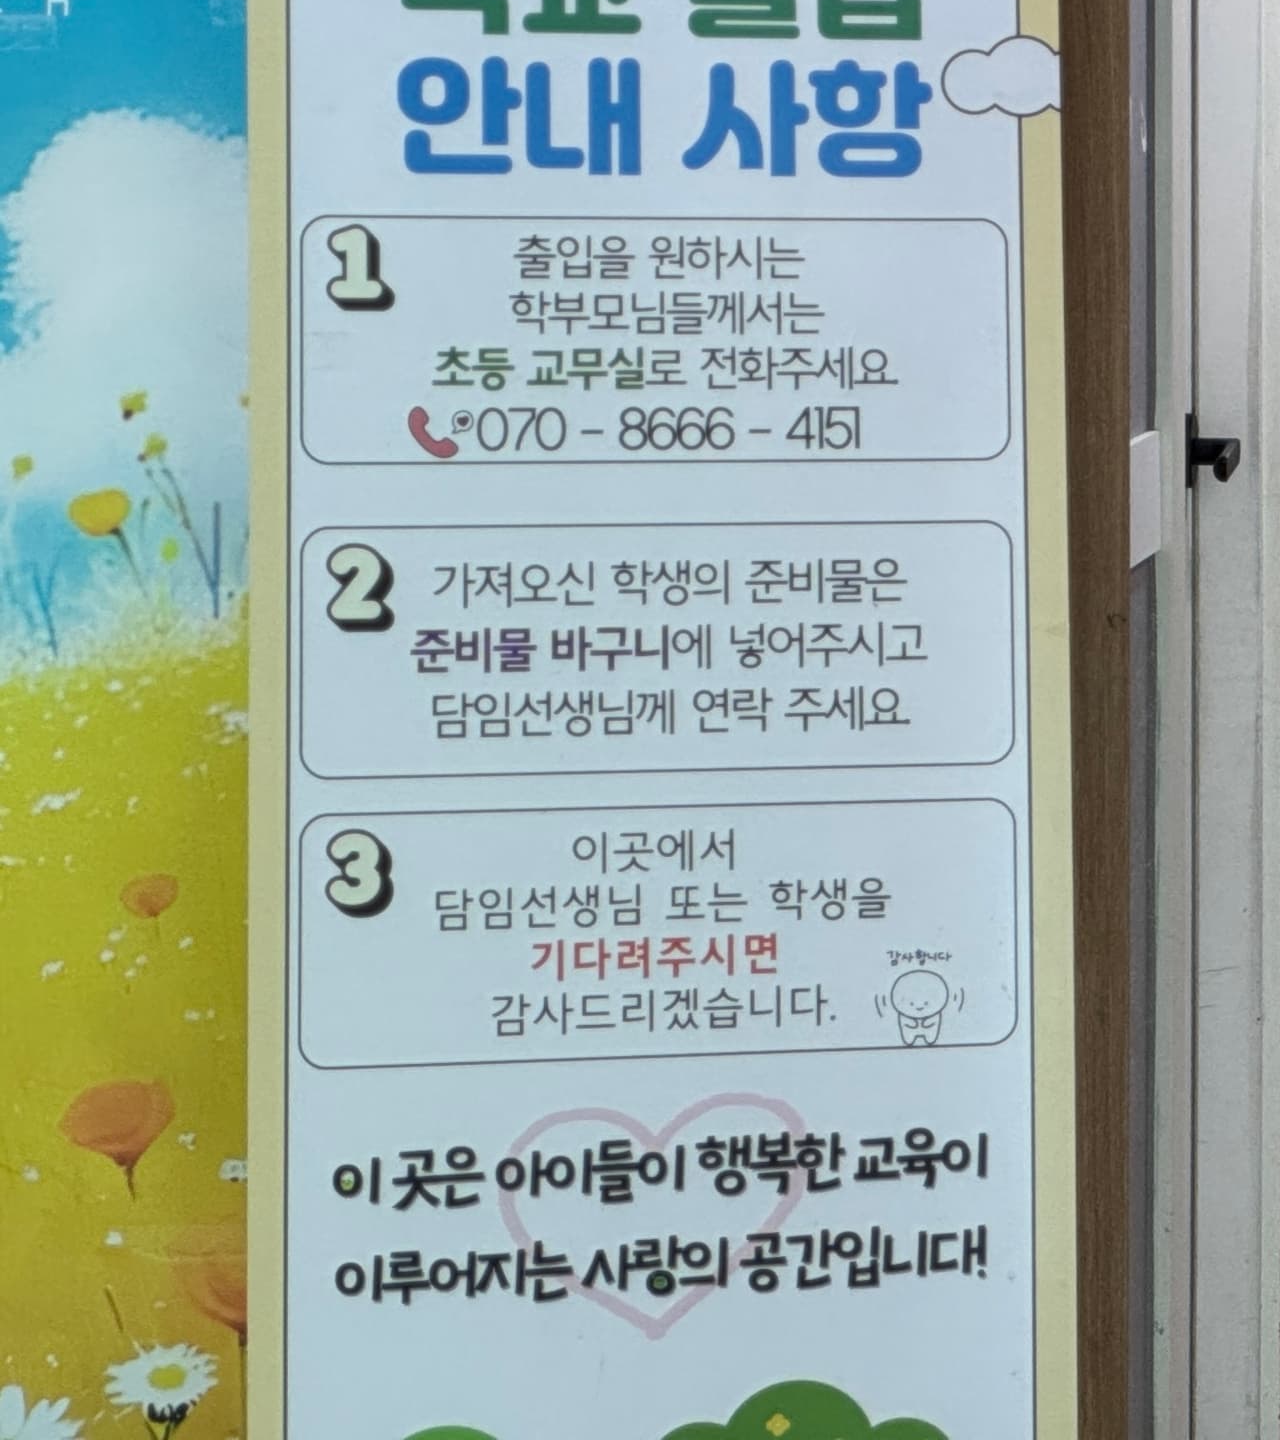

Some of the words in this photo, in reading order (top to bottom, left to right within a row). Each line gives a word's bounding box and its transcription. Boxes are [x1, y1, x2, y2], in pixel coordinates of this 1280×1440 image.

[397, 57, 642, 177] 안내
[683, 58, 933, 178] 사항
[326, 224, 395, 311] 1
[513, 235, 635, 280] 출입을
[649, 235, 805, 280] 원하시는
[510, 291, 824, 335] 학부모님들께서는
[432, 348, 515, 390] 초등
[527, 346, 686, 389] 교무실로
[700, 348, 899, 389] 전화주세요
[326, 543, 395, 633] 2
[432, 561, 597, 610] 가져오신
[612, 558, 731, 607] 학생의
[744, 558, 908, 605] 준비물은
[409, 628, 536, 674] 준비물
[551, 625, 713, 672] 바구니에
[731, 623, 928, 670] 넣어주시고
[431, 690, 676, 739] 담임선생님께
[693, 689, 771, 731] 연락
[785, 687, 910, 731] 주세요
[325, 829, 394, 917] 3
[572, 827, 737, 874] 이곳에서
[434, 882, 644, 931] 담임선생님
[667, 882, 748, 923] 또는
[771, 877, 891, 923] 학생을
[531, 932, 780, 981] 기다려주시면
[887, 948, 952, 966] 감사합니다
[491, 984, 838, 1036] 감사드리겠습니다.
[495, 1140, 685, 1203] 아이들이
[696, 1132, 846, 1194] 행복한
[853, 1127, 989, 1186] 교육이
[335, 1241, 572, 1305] 이루어지는
[582, 1236, 728, 1295] 사랑의
[738, 1225, 989, 1292] 공간입니다!
